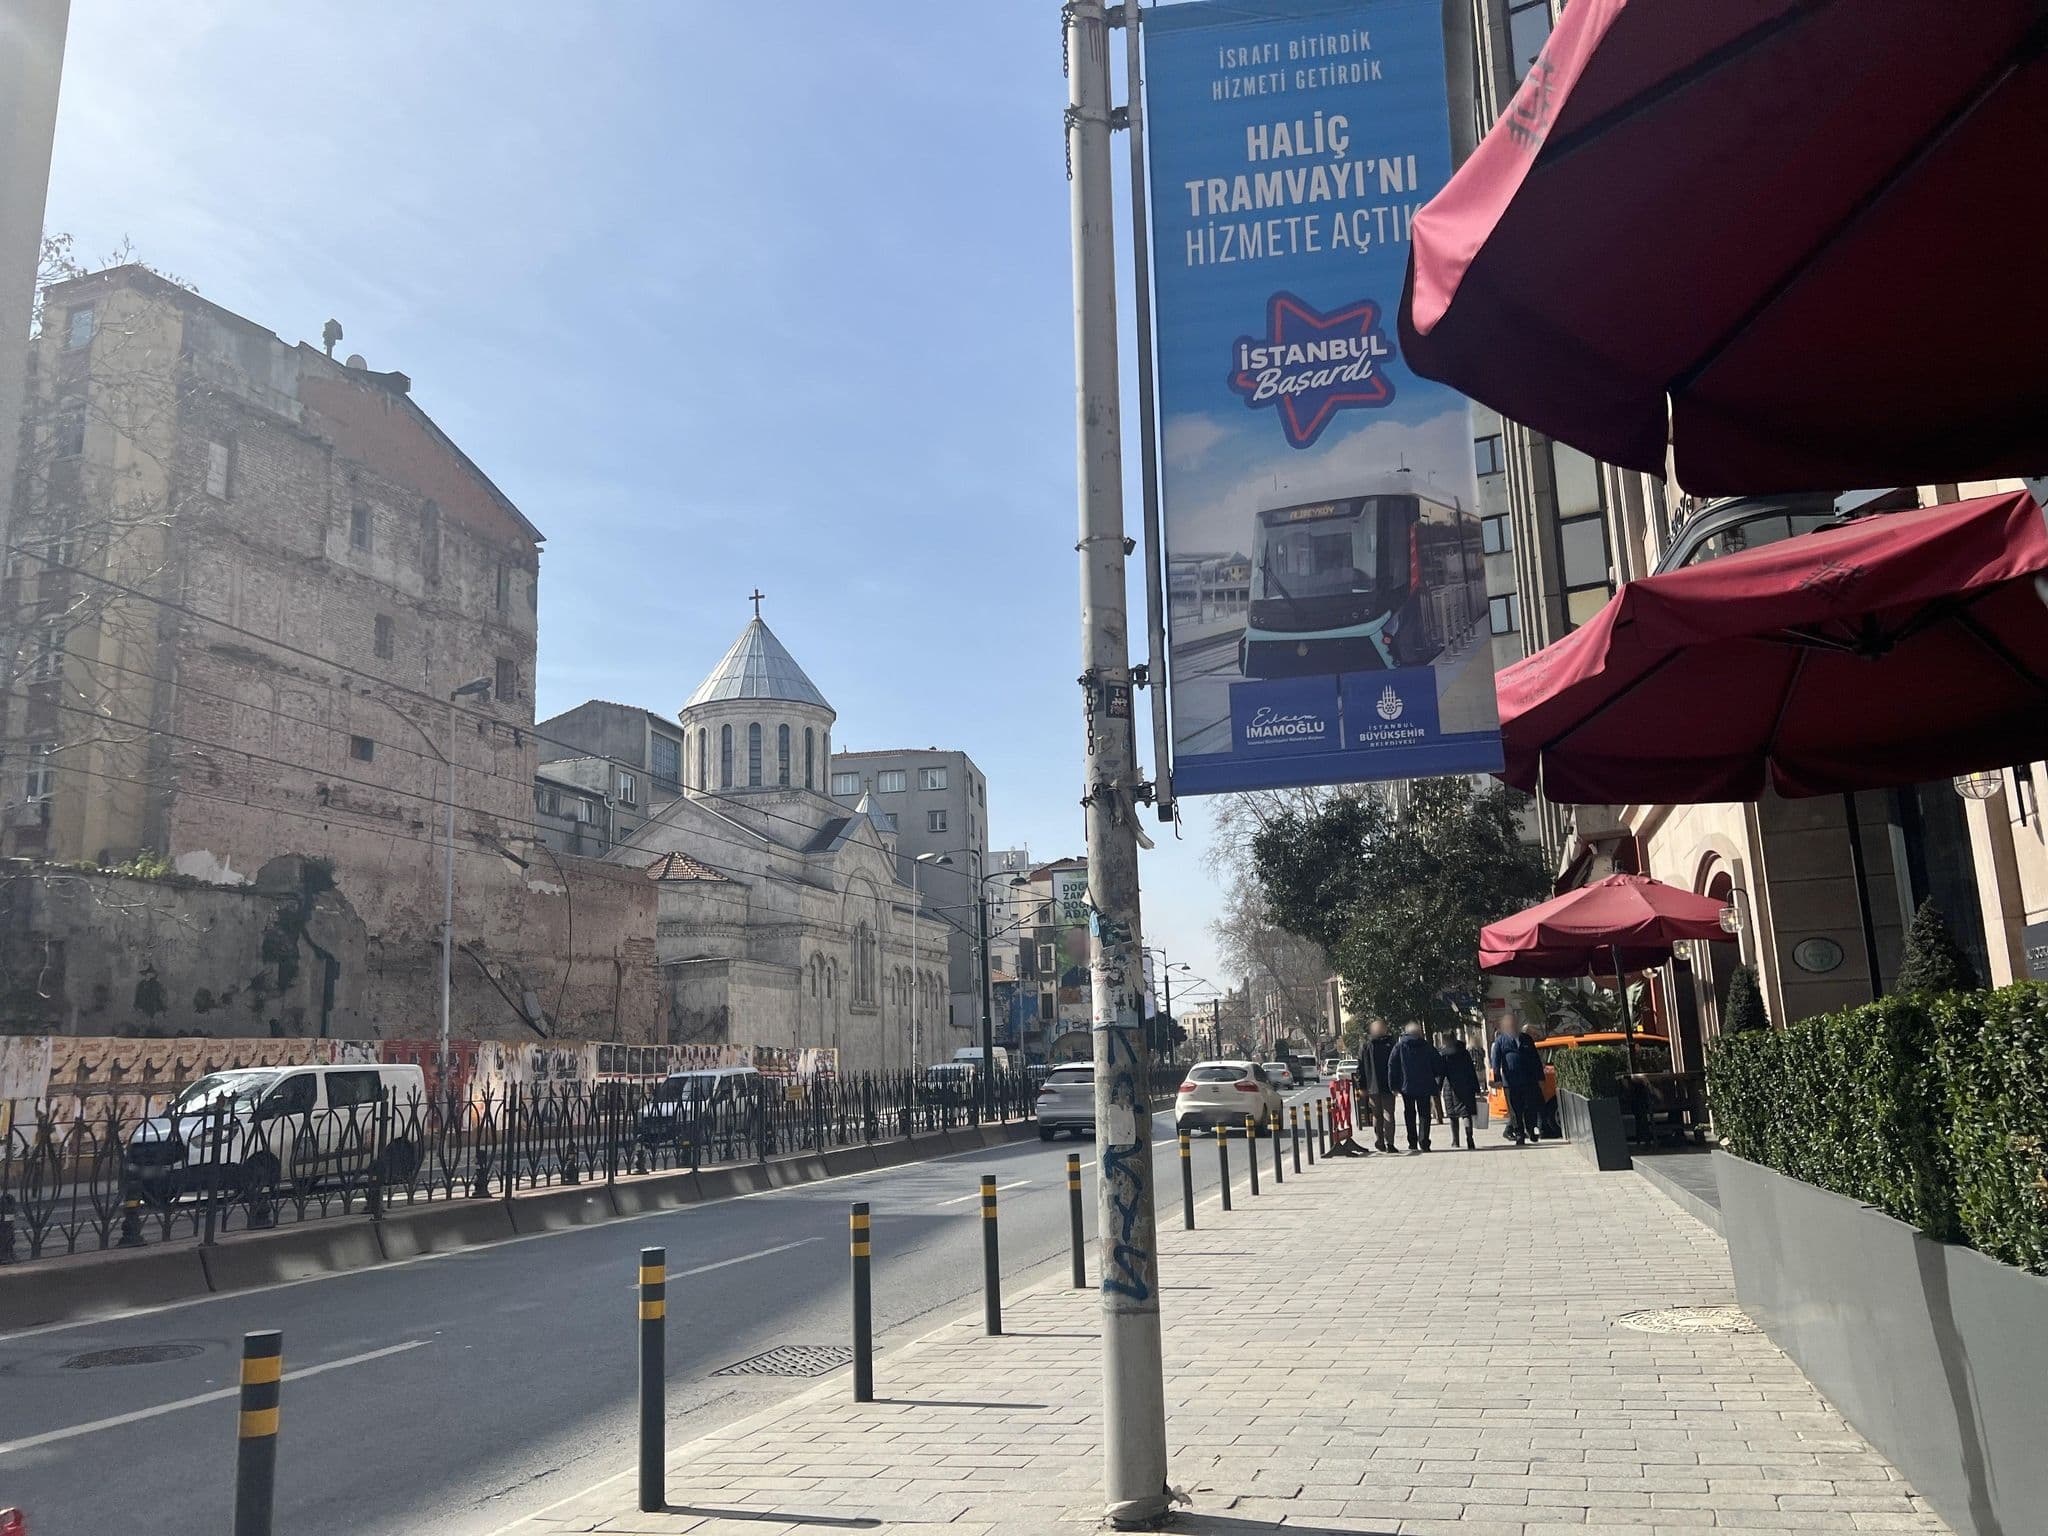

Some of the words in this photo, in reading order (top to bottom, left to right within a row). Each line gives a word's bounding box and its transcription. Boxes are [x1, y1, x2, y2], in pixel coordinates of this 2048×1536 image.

[1219, 43, 1279, 69] İSRAFI
[1289, 29, 1371, 60] BİTİRDİK
[1212, 69, 1286, 101] HİZMETİ
[1295, 58, 1383, 90] GETİRDİK
[1246, 111, 1349, 160] HALİÇ
[1185, 155, 1417, 217] TRAMVAYI’NI
[1186, 215, 1321, 267] HİZMETE
[1241, 335, 1387, 371] İSTANBUL
[1253, 350, 1373, 401] Başardı
[1246, 721, 1325, 739] İMAMOĞLU
[1063, 891, 1085, 900] ZAM
[1065, 909, 1091, 919] ADA
